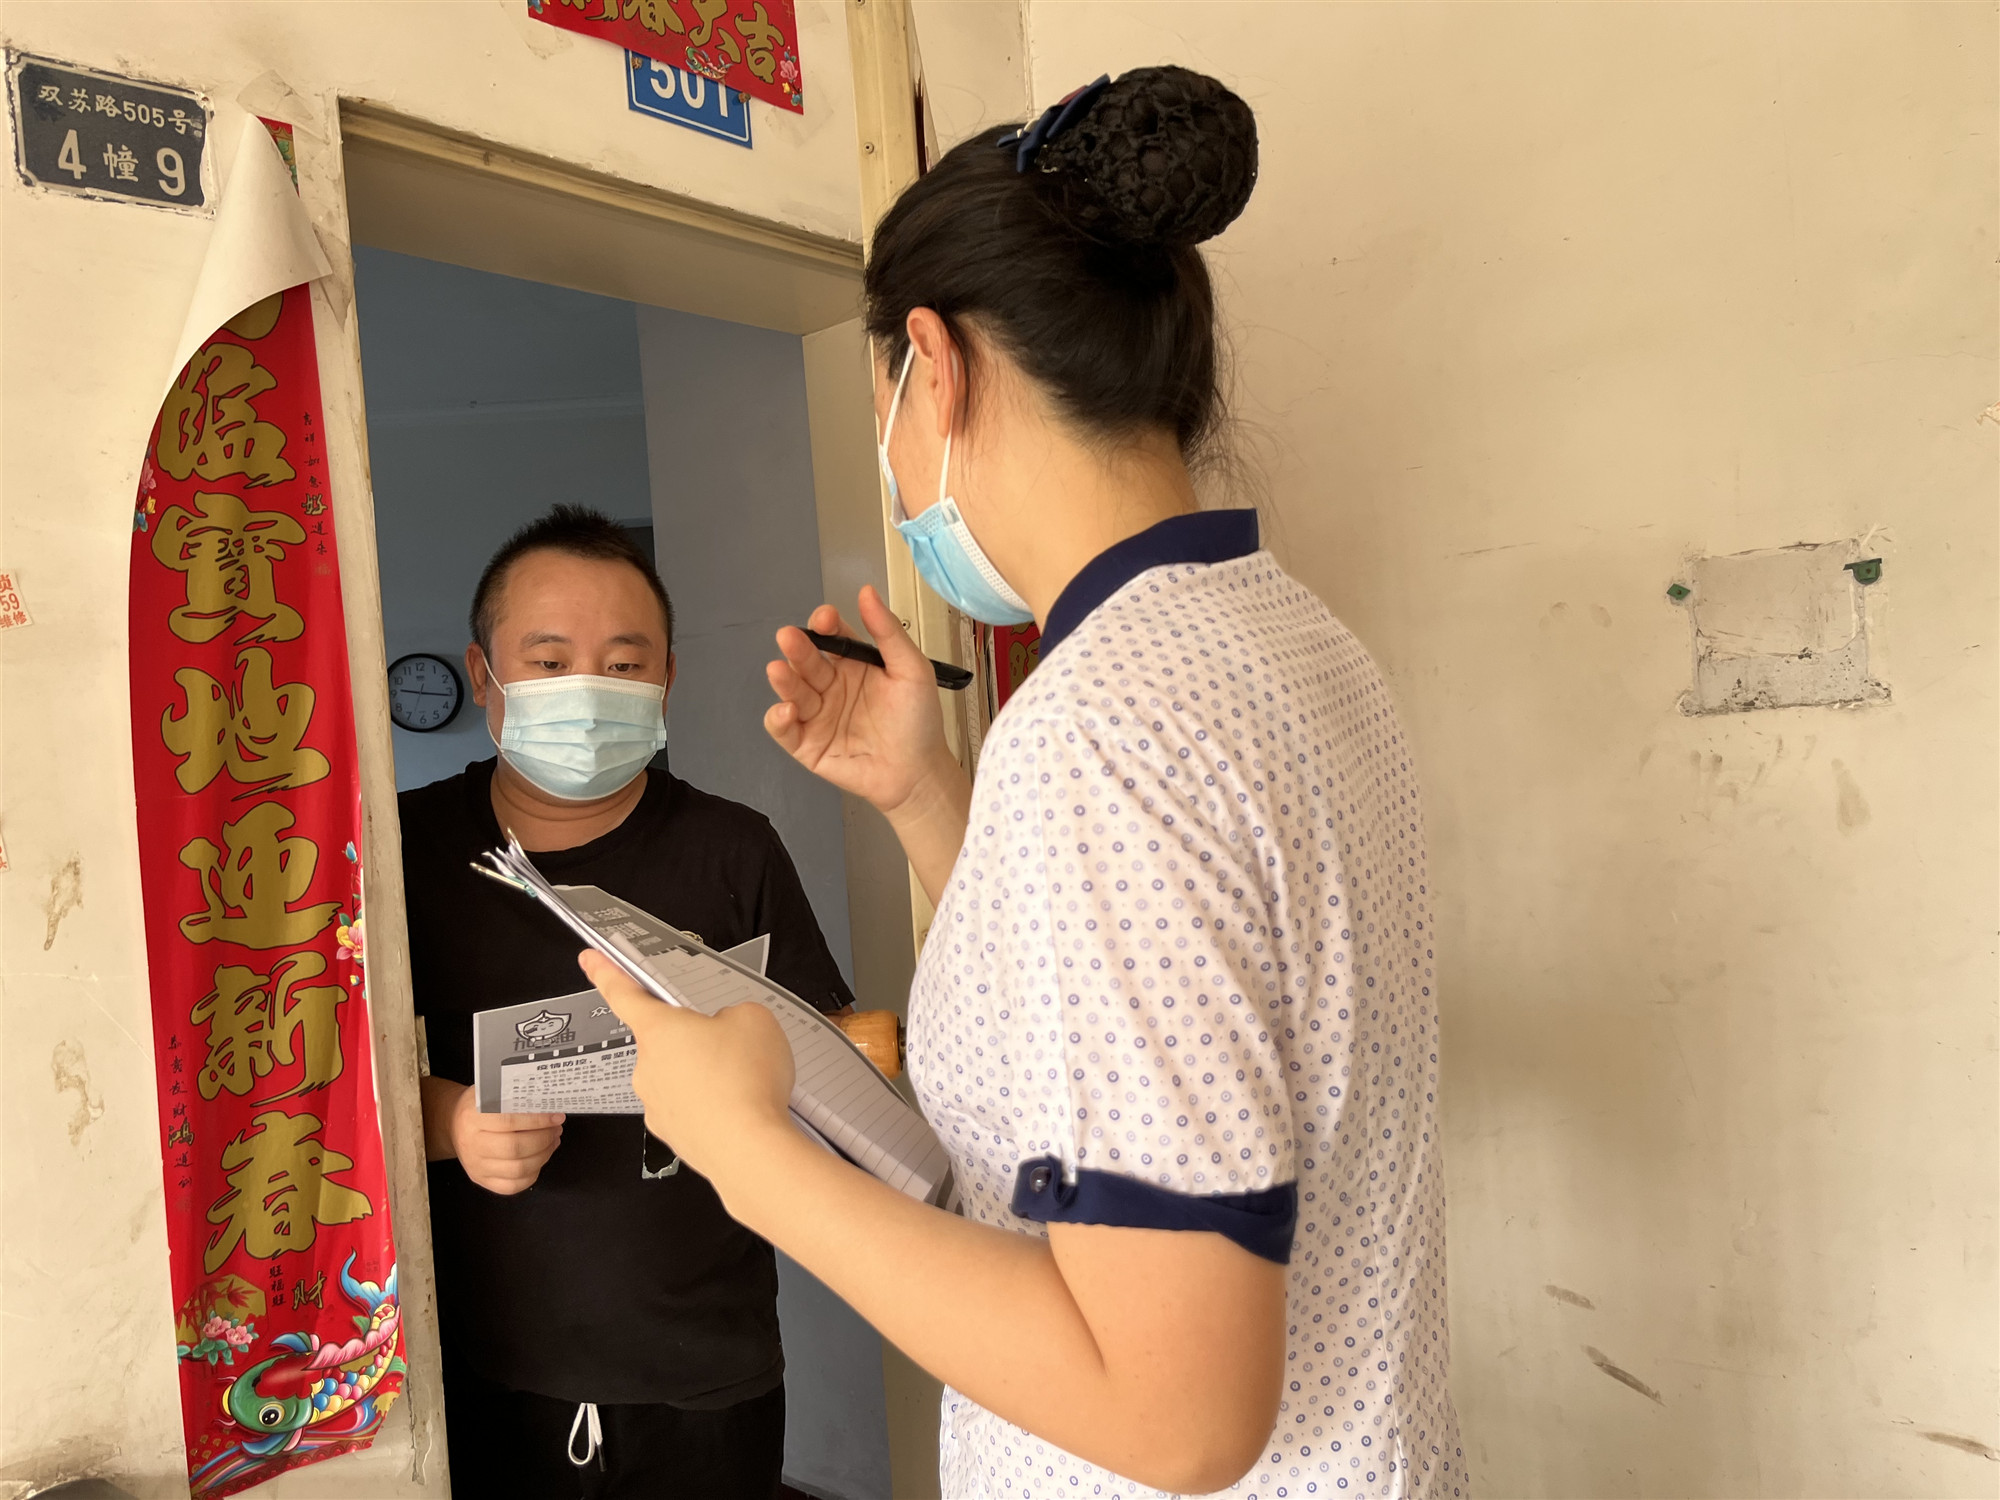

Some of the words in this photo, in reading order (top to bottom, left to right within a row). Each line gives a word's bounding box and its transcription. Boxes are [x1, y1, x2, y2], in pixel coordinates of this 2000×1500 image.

[38, 84, 193, 135] 双苏路505号
[403, 666, 412, 676] 11
[415, 662, 425, 672] 12
[432, 665, 436, 674] 1
[394, 676, 403, 686] 10
[441, 674, 449, 684] 2
[445, 687, 453, 697] 3
[395, 702, 403, 712] 8
[442, 701, 449, 709] 4
[406, 711, 412, 721] 7
[419, 714, 427, 724] 6
[432, 710, 440, 720] 5
